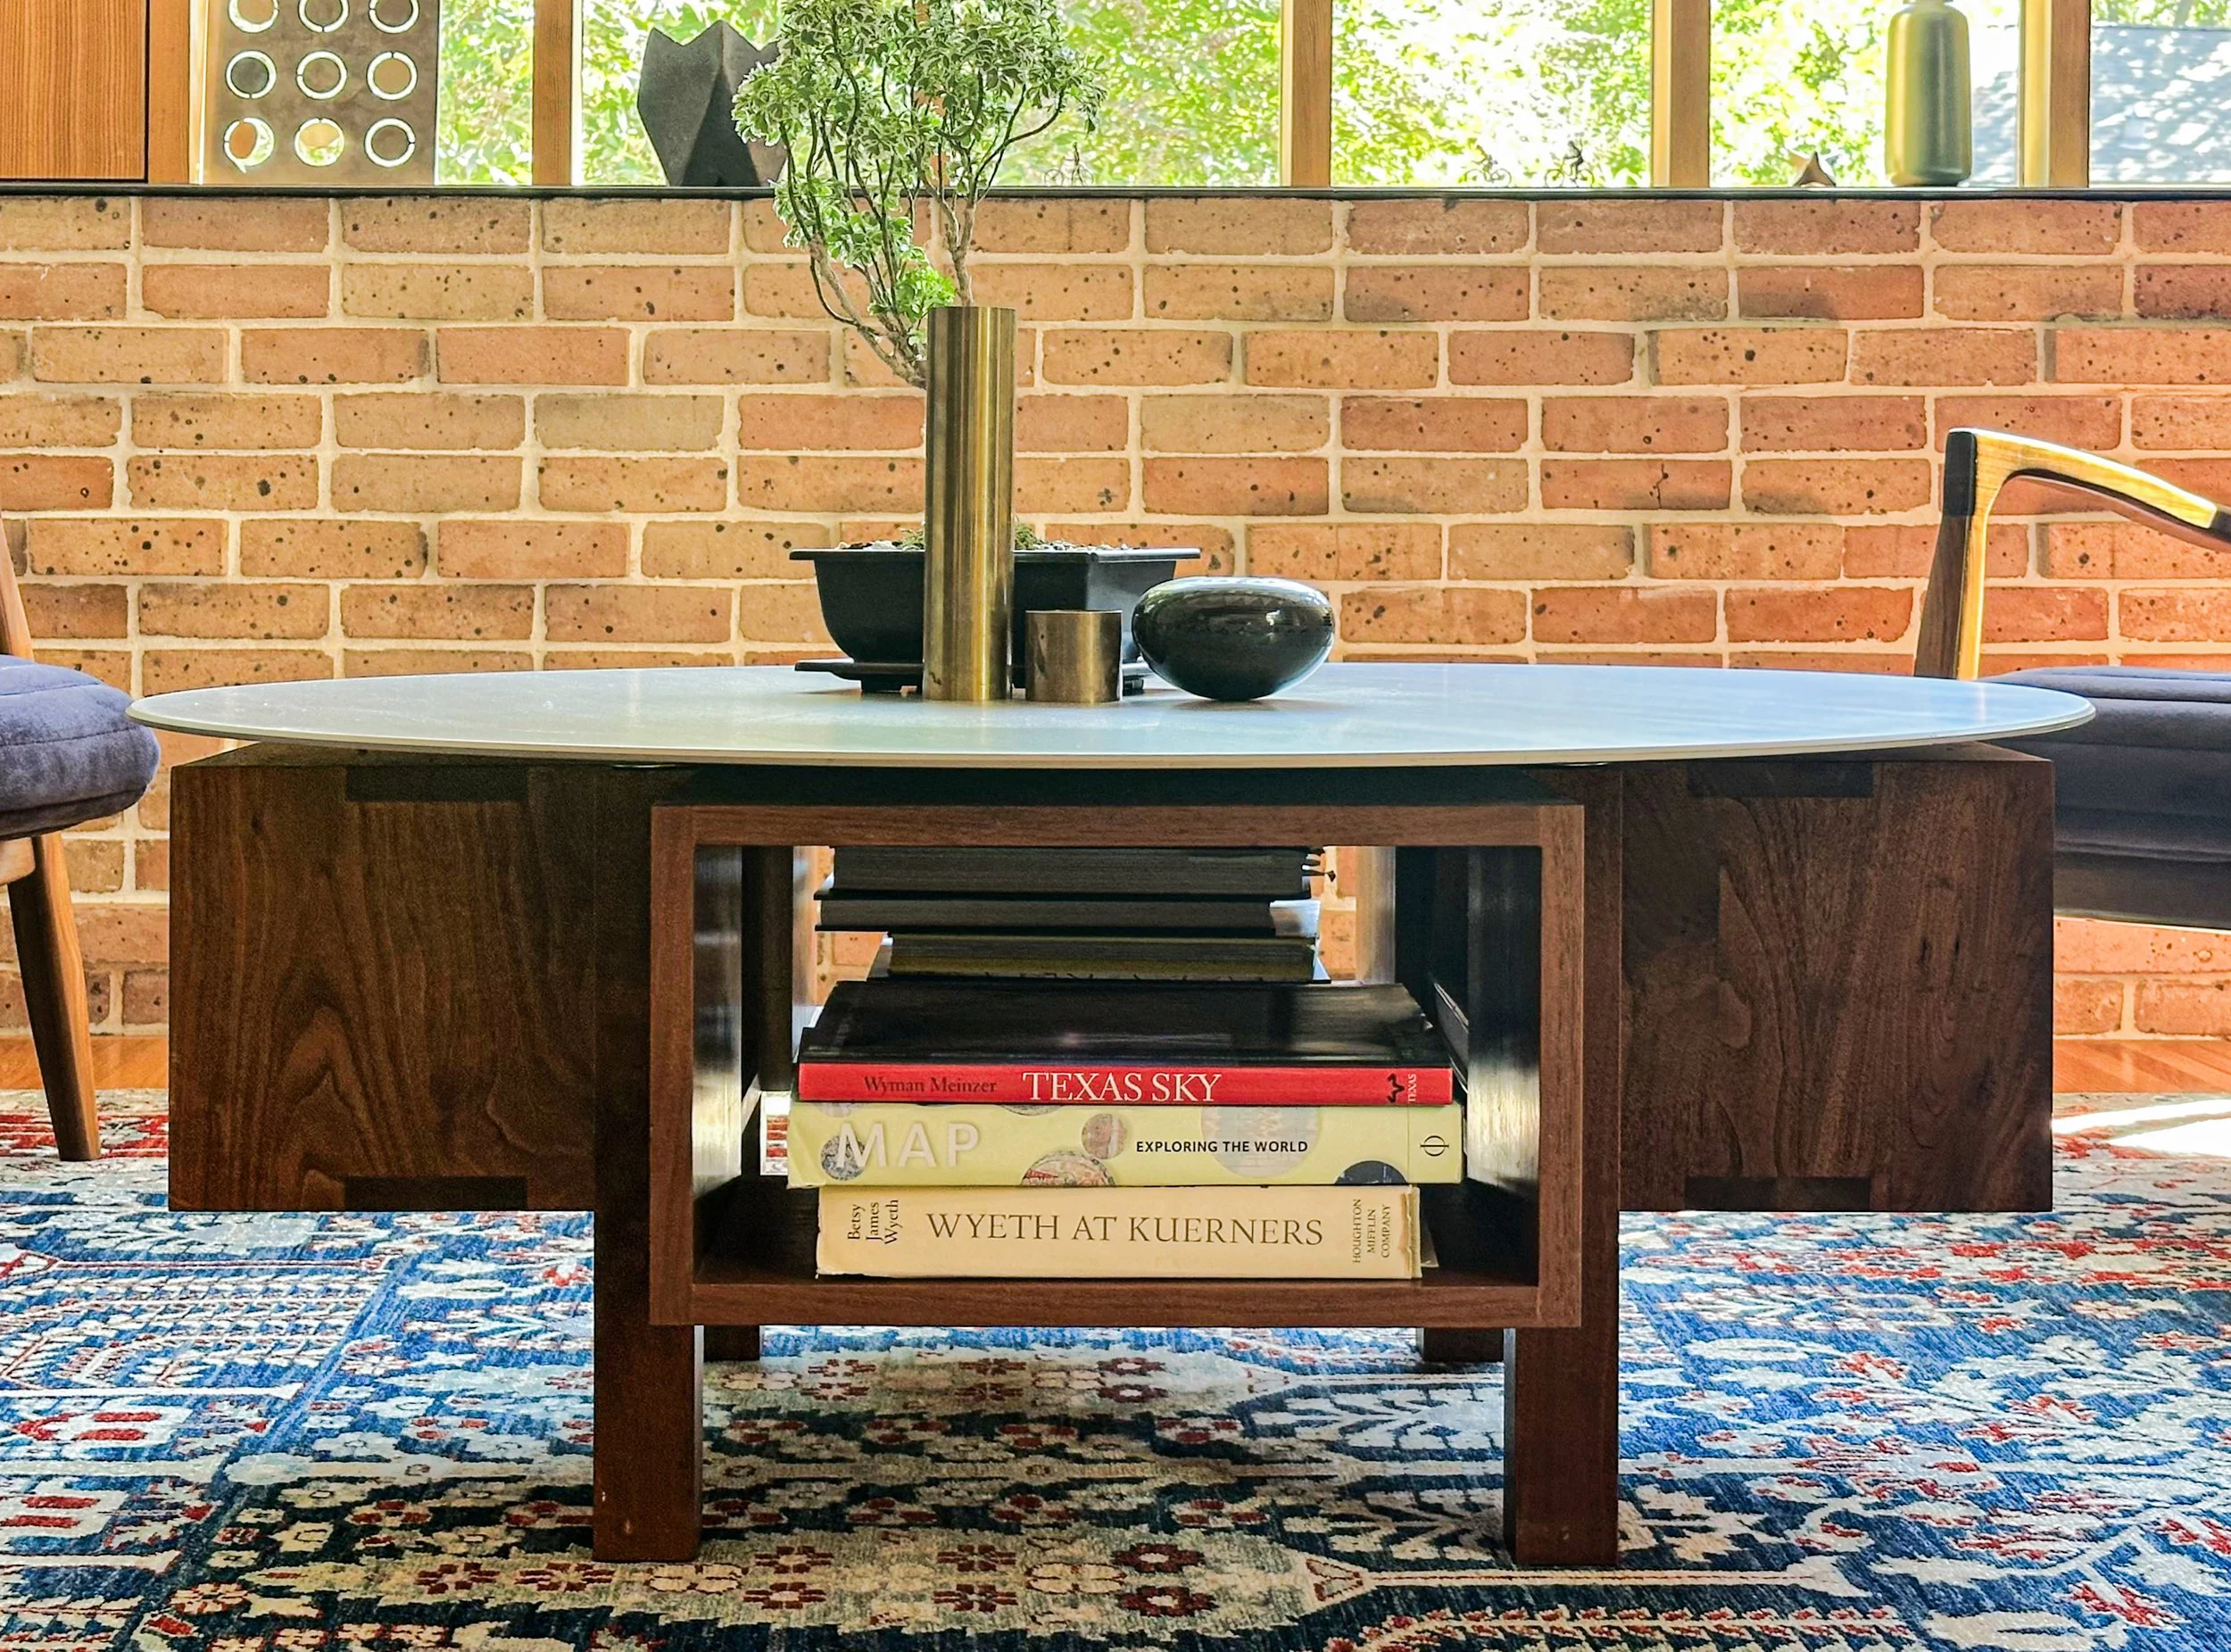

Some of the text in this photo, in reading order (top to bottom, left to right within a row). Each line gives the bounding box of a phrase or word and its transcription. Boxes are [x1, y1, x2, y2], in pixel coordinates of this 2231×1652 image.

[864, 1075, 997, 1093] Wyman Meinzer
[1023, 1072, 1222, 1102] TEXAS SKY
[1407, 1073, 1417, 1102] TEXAS
[835, 1123, 979, 1168] MAP
[1136, 1140, 1308, 1154] EXPLORING THE WORLD
[847, 1203, 866, 1241] Betsy
[865, 1201, 880, 1241] James
[883, 1199, 903, 1244] Wyeth
[926, 1213, 1323, 1246] WYETH AT KUERNERS
[1352, 1198, 1362, 1264] HOUGHTON
[1367, 1208, 1377, 1254] MIFFLIN
[1381, 1203, 1391, 1258] COMPANY
